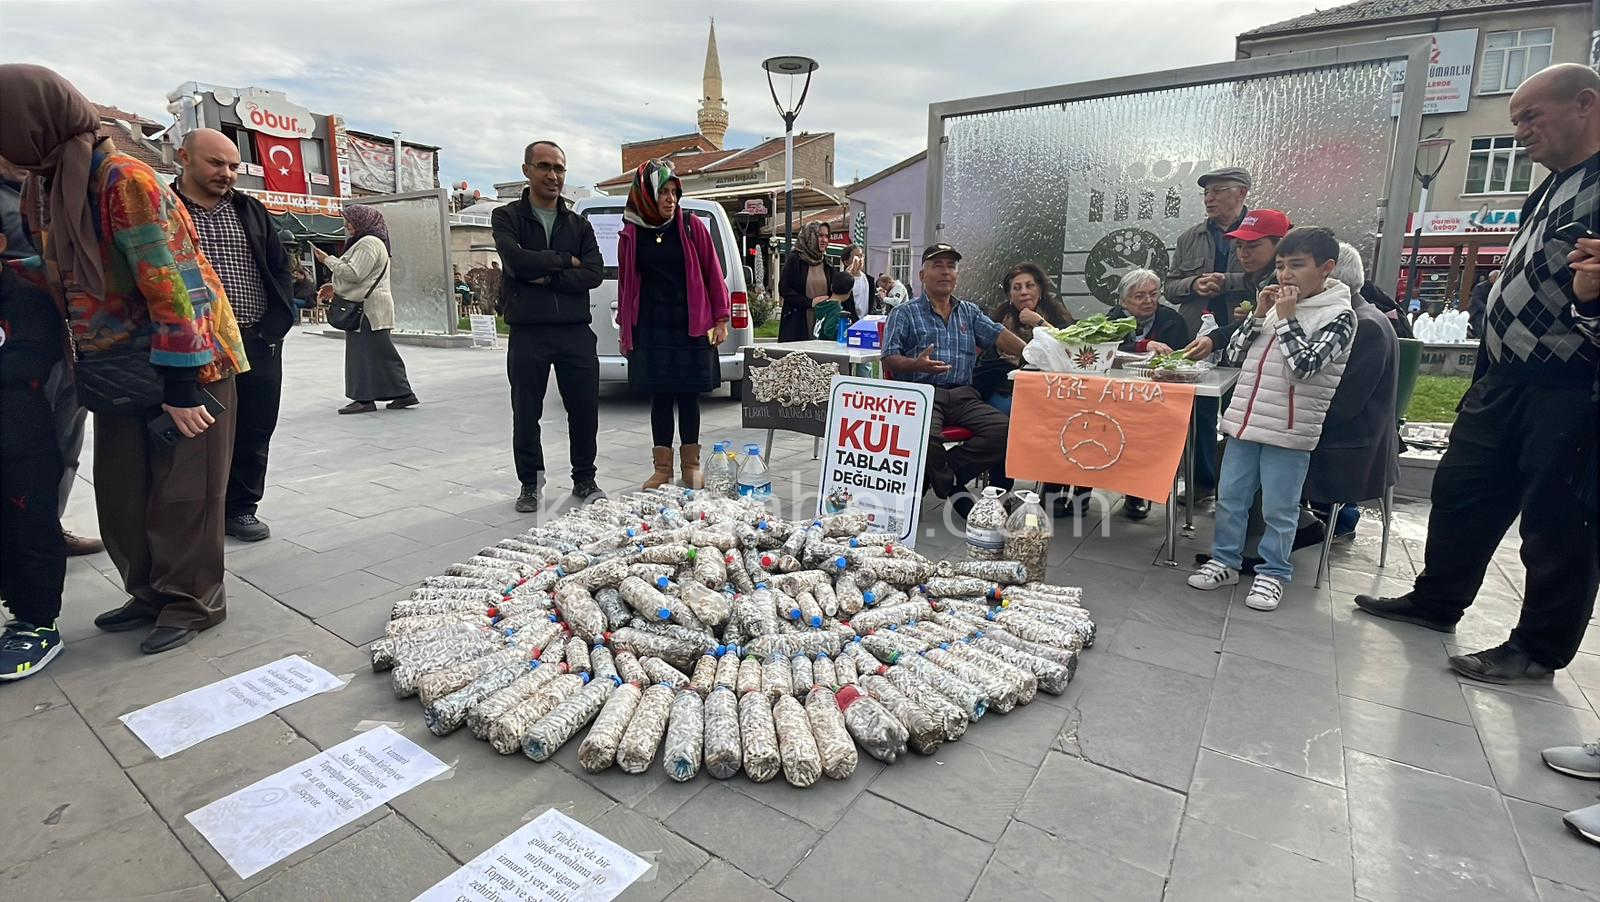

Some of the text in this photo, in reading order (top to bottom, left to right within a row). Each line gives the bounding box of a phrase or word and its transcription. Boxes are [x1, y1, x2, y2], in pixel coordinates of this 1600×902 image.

[842, 391, 917, 417] TÜRKİYE
[838, 413, 910, 458] KÜL
[836, 449, 909, 477] TABLASI
[524, 852, 581, 891] milyon sigara
[527, 838, 557, 855] günde
[554, 851, 592, 878] ortalama
[596, 856, 610, 869] bir
[523, 873, 549, 892] yere
